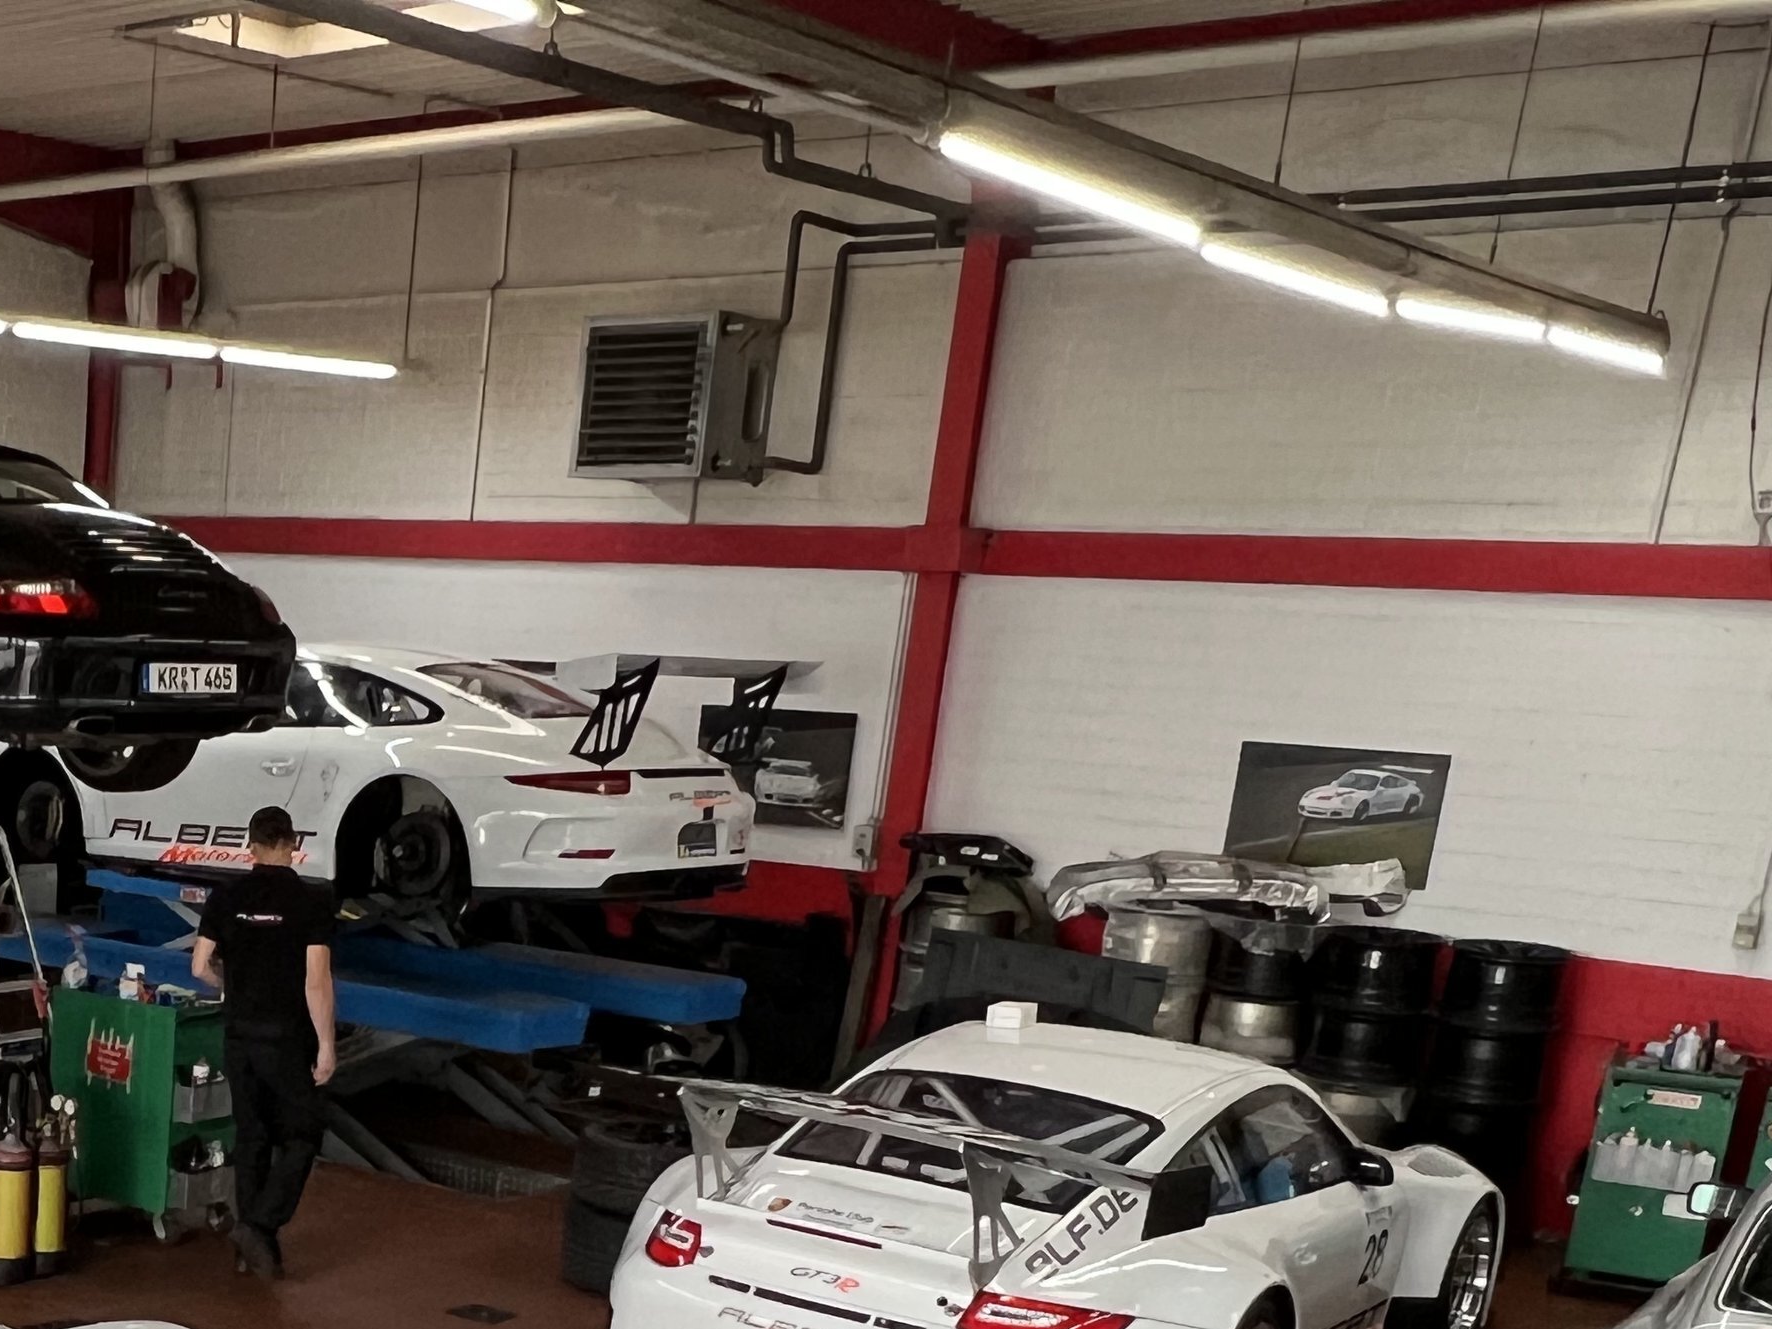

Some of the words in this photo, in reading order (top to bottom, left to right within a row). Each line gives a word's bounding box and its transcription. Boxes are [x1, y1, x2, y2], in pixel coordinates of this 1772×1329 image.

[157, 666, 179, 690] KR
[190, 667, 202, 691] T
[204, 666, 233, 690] 465
[108, 818, 318, 851] ALBET
[1357, 1228, 1389, 1288] 28
